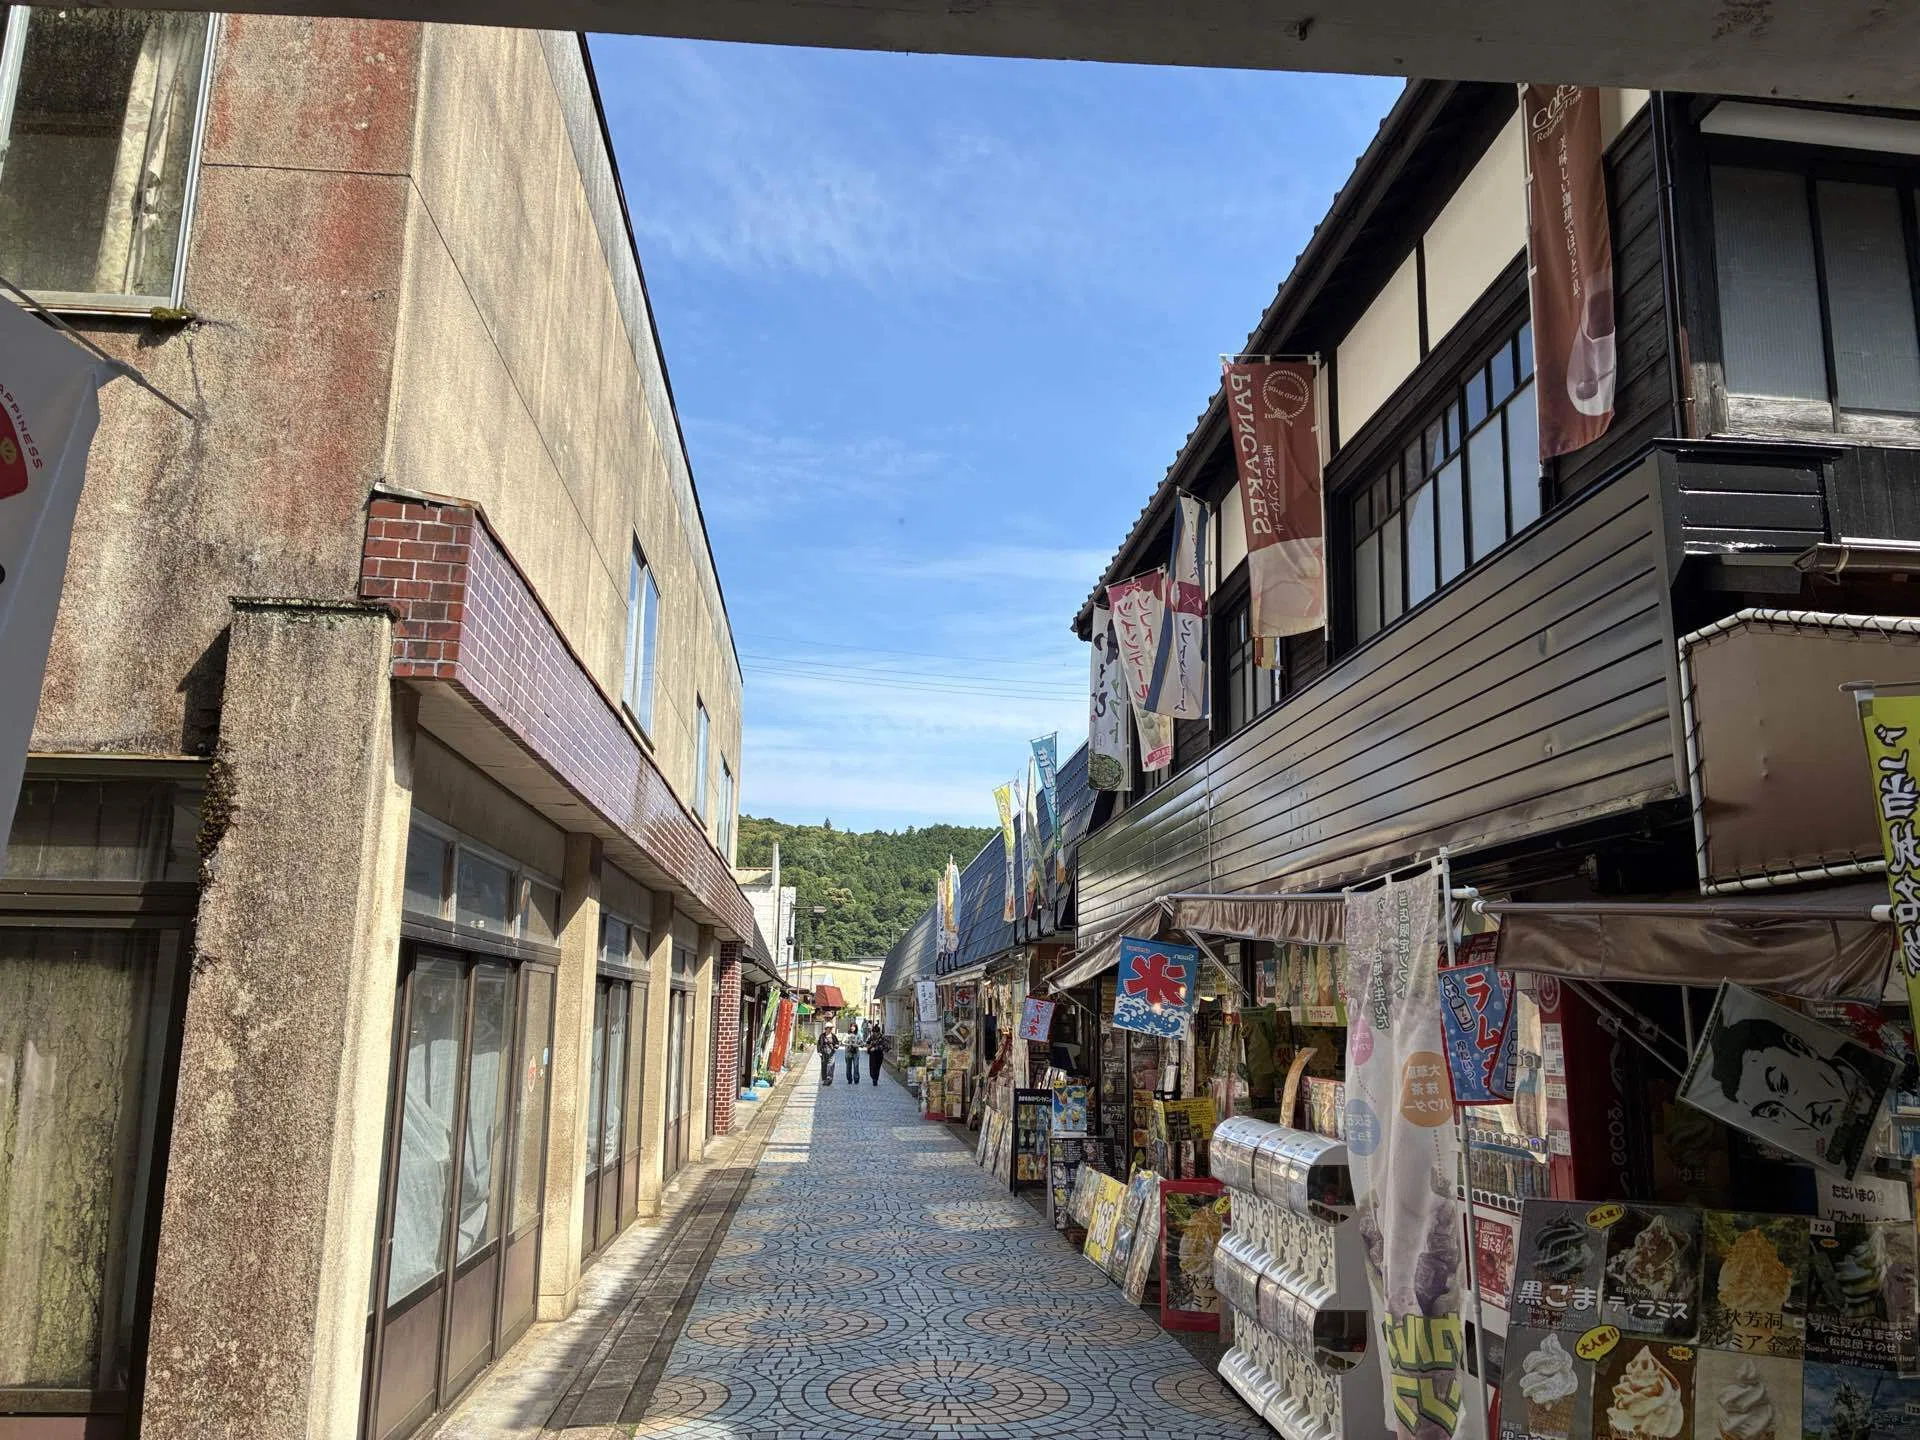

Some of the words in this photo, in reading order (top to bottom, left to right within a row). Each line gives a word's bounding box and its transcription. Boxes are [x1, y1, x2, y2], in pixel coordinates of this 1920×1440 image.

[1831, 1184, 1876, 1203] ただいまの
[1516, 1279, 1597, 1311] 黒ごま
[1607, 1295, 1689, 1321] ティラミス
[1725, 1308, 1783, 1330] 秋芳洞
